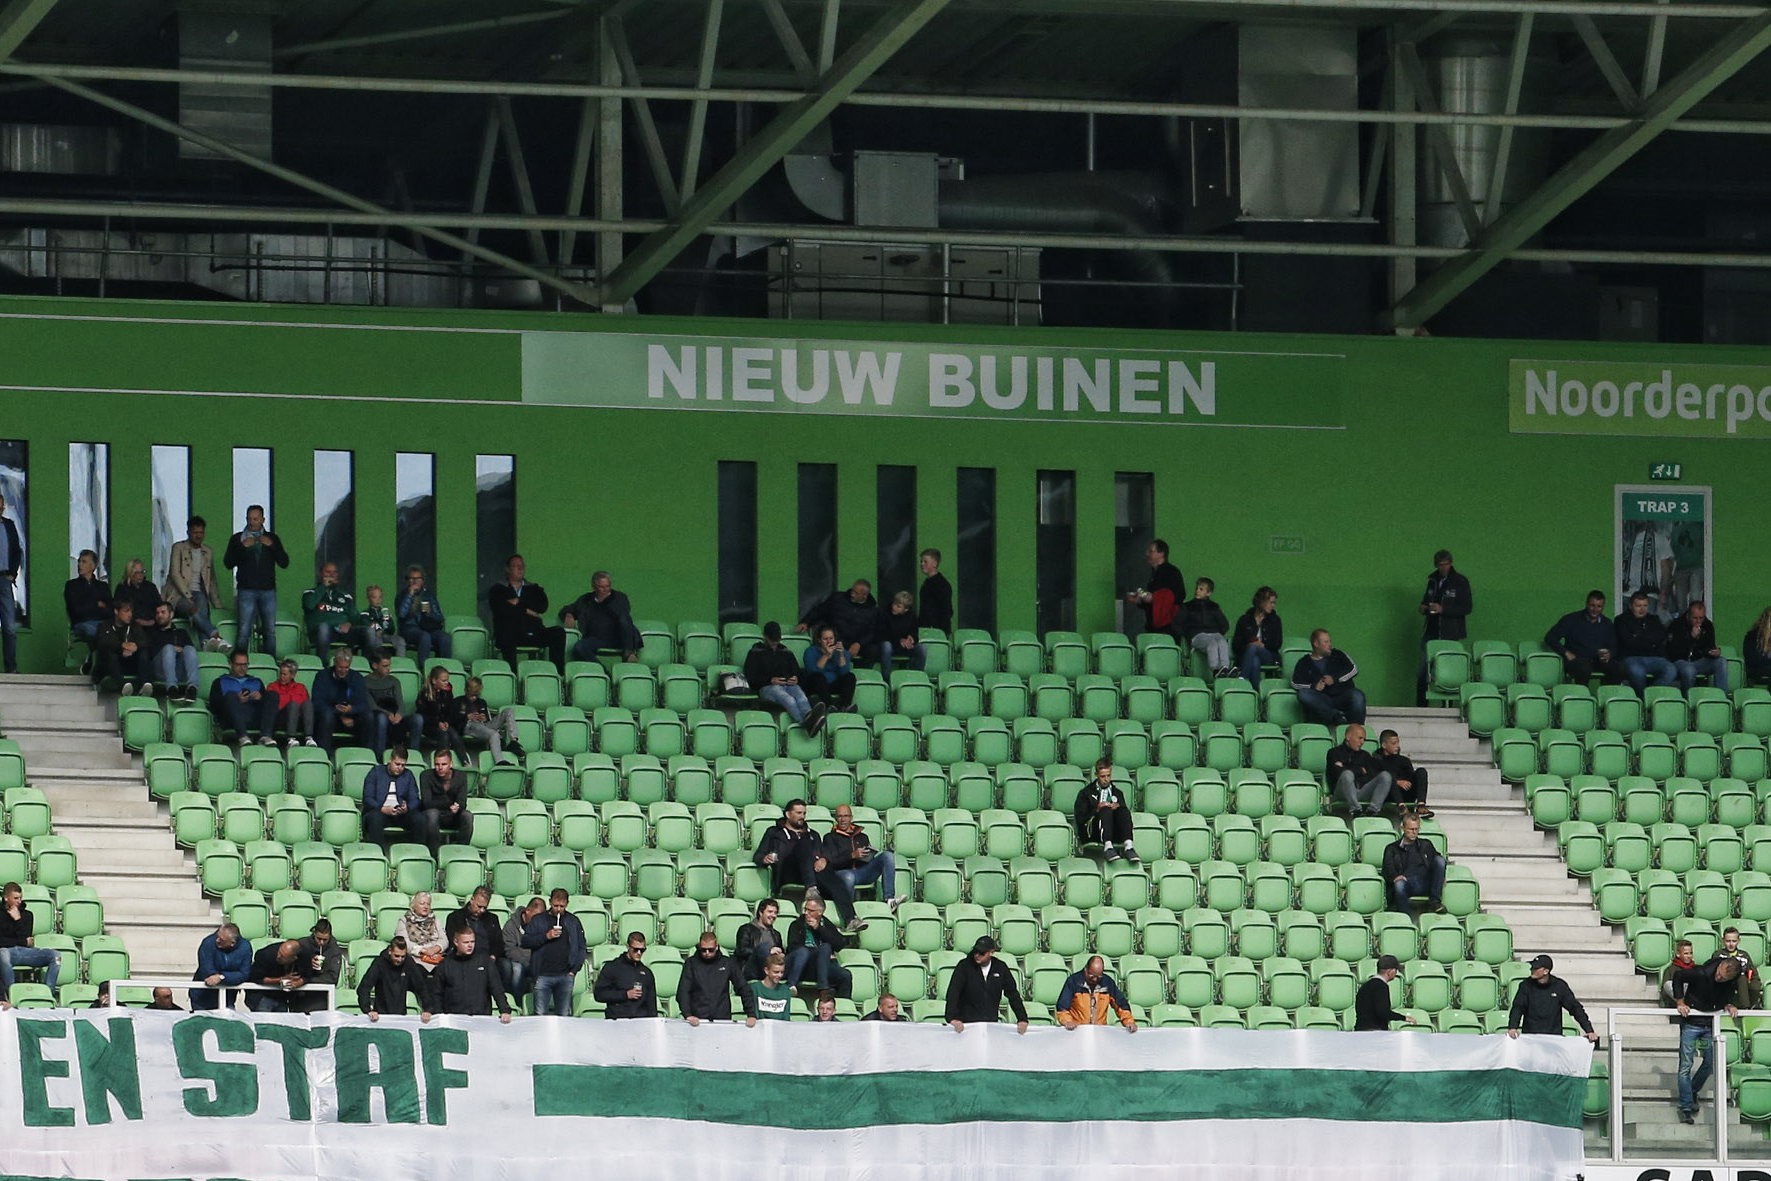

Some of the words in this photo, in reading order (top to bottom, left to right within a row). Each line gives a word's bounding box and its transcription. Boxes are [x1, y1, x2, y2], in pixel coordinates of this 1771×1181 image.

[648, 344, 902, 405] NIEUW
[928, 353, 1216, 415] BUINEN
[1637, 500, 1676, 513] TRAP
[1680, 502, 1689, 513] 3
[24, 1016, 143, 1127] EN
[173, 1014, 470, 1126] STAF
